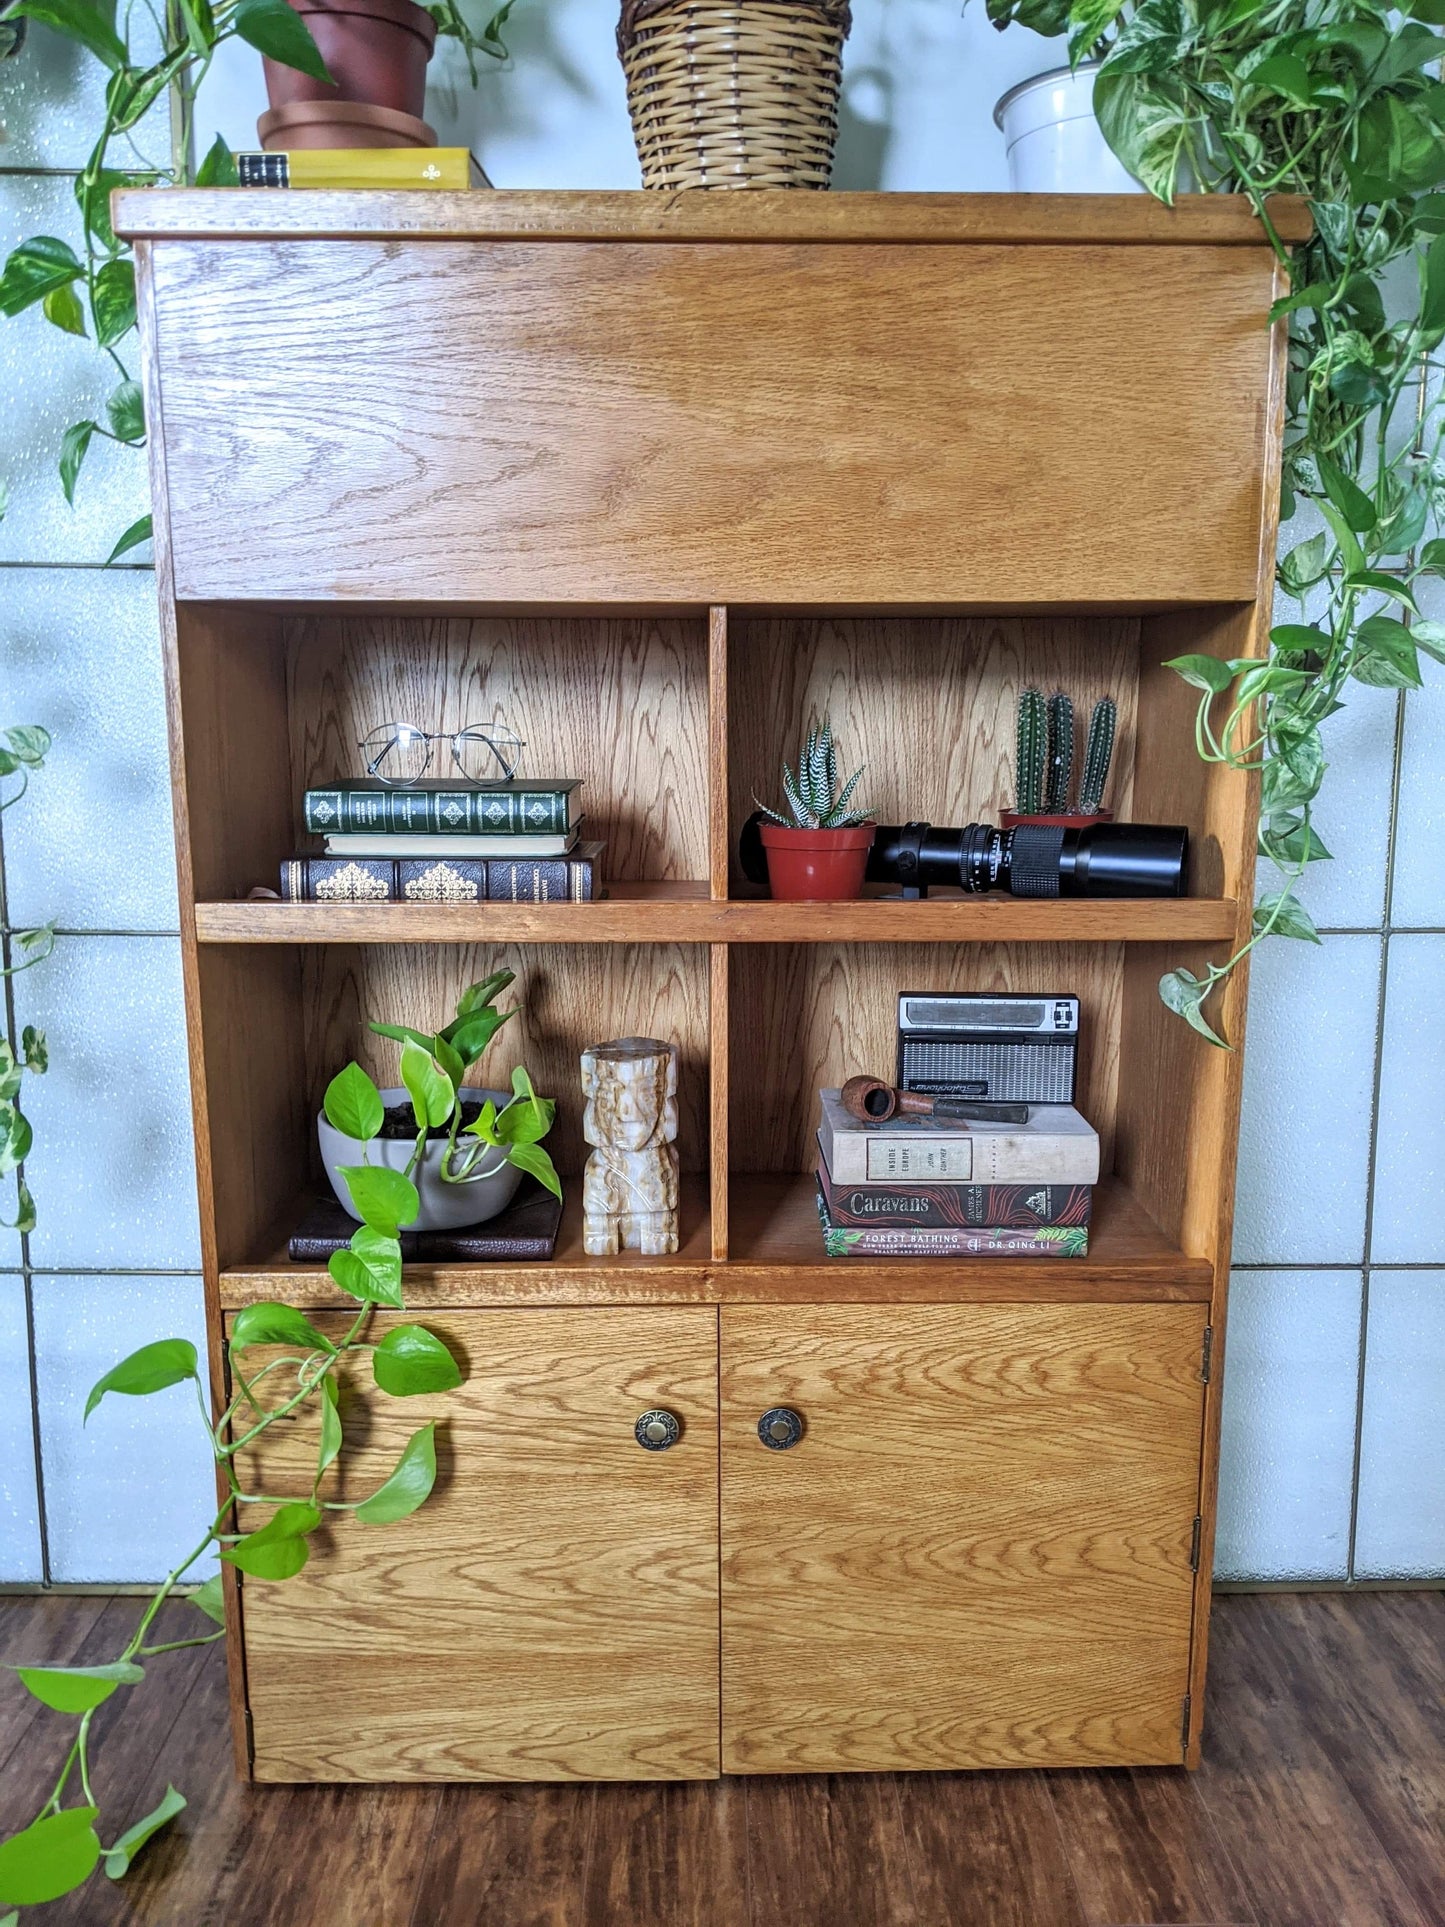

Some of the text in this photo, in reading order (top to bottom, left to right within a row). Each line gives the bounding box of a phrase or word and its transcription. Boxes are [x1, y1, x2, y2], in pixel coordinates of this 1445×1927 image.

[888, 1148, 896, 1172] INSIDE
[850, 1193, 929, 1214] Caravans
[865, 1234, 958, 1243] FOREST BATHING
[988, 1241, 1005, 1249] DR.
[1008, 1241, 1036, 1249] QING
[1040, 1241, 1050, 1249] LI
